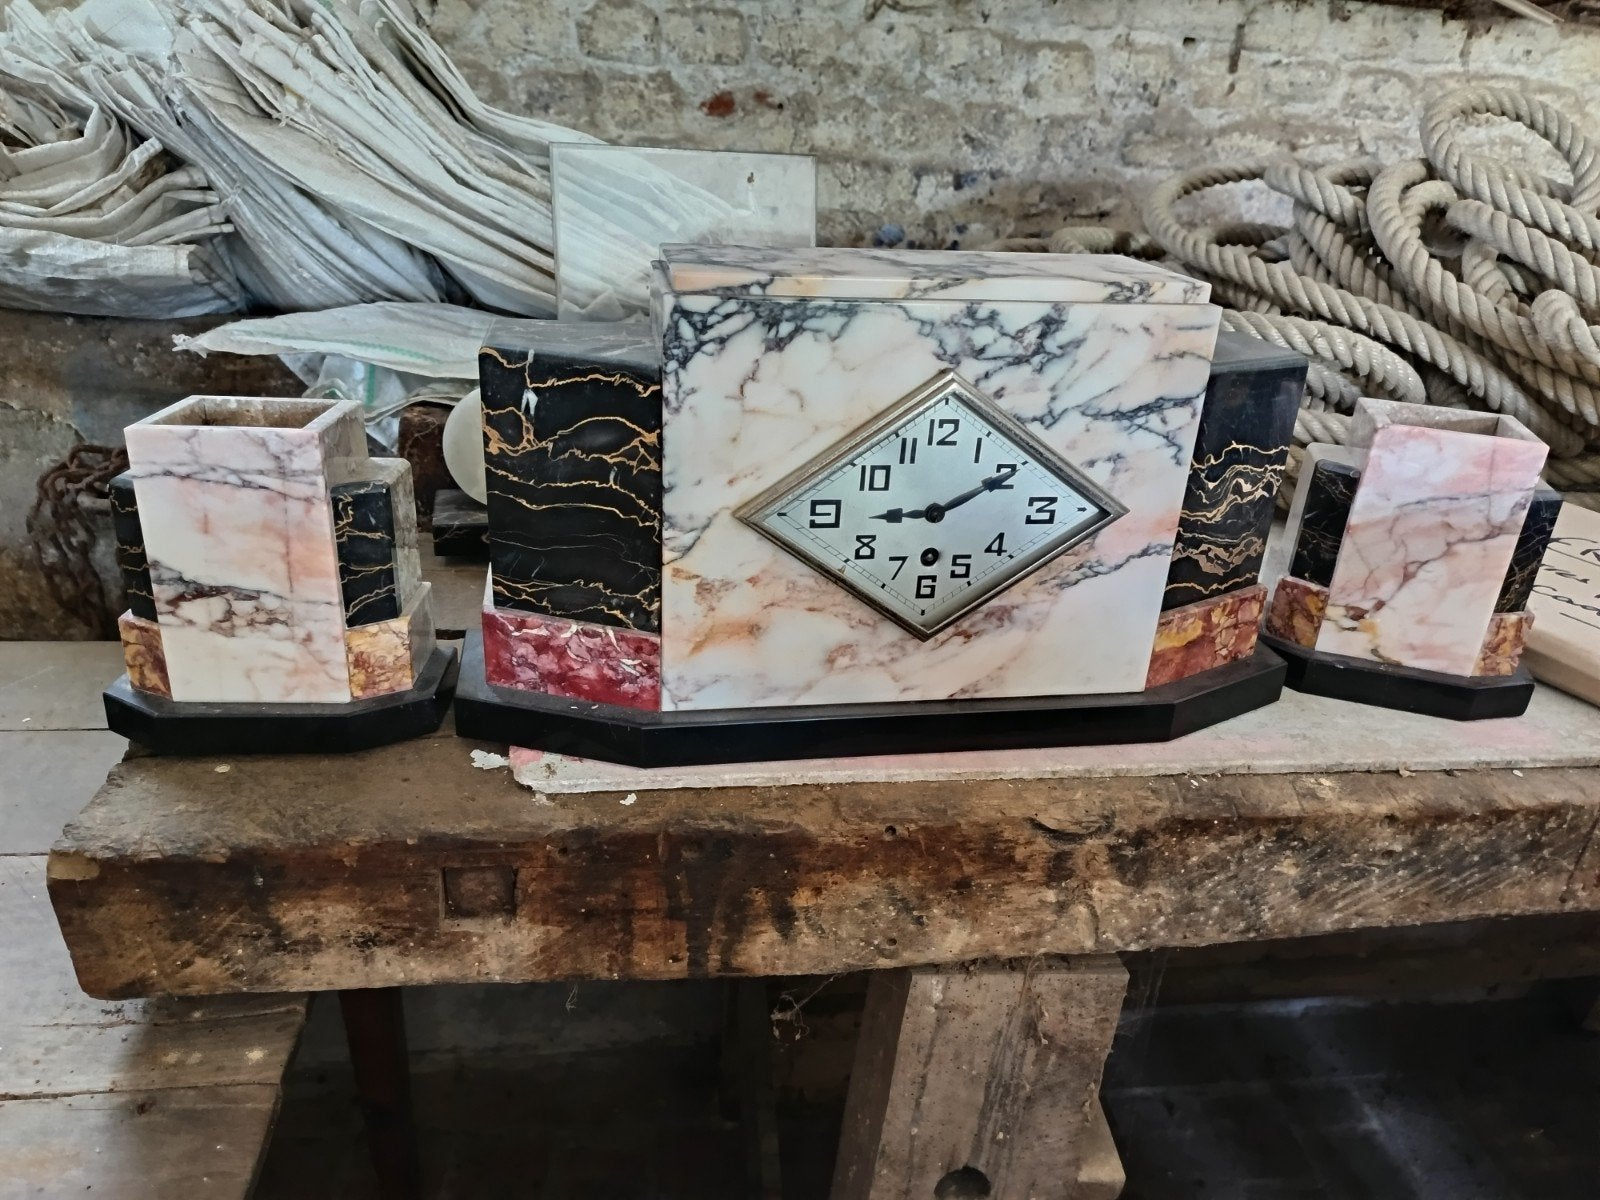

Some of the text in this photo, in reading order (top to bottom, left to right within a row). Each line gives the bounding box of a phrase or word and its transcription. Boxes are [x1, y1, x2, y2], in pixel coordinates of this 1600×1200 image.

[926, 418, 961, 447] 12
[898, 437, 919, 465] 11
[973, 437, 984, 464] 1
[858, 464, 892, 492] 10
[994, 463, 1018, 490] 2
[808, 498, 843, 529] 9
[1024, 496, 1059, 525] 3
[854, 534, 877, 560] 8
[983, 532, 1008, 557] 4
[888, 555, 910, 581] 7
[949, 554, 973, 579] 5
[914, 574, 938, 600] 6
